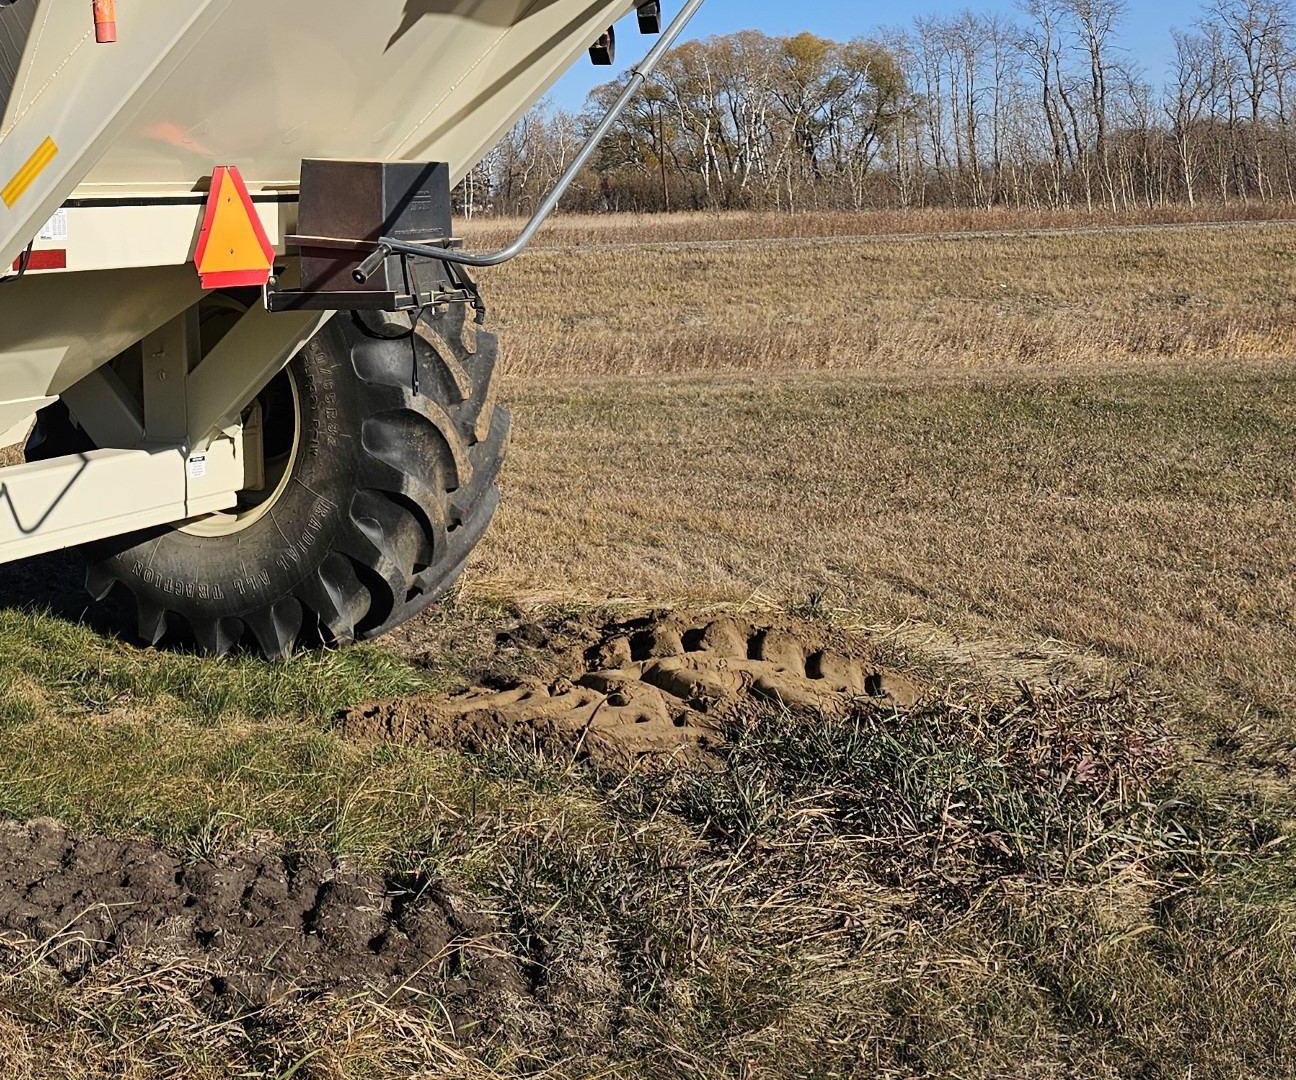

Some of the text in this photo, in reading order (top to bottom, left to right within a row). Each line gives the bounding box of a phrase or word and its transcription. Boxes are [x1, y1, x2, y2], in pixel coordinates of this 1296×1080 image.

[131, 498, 332, 600] RADIAL ALL TRACTION
